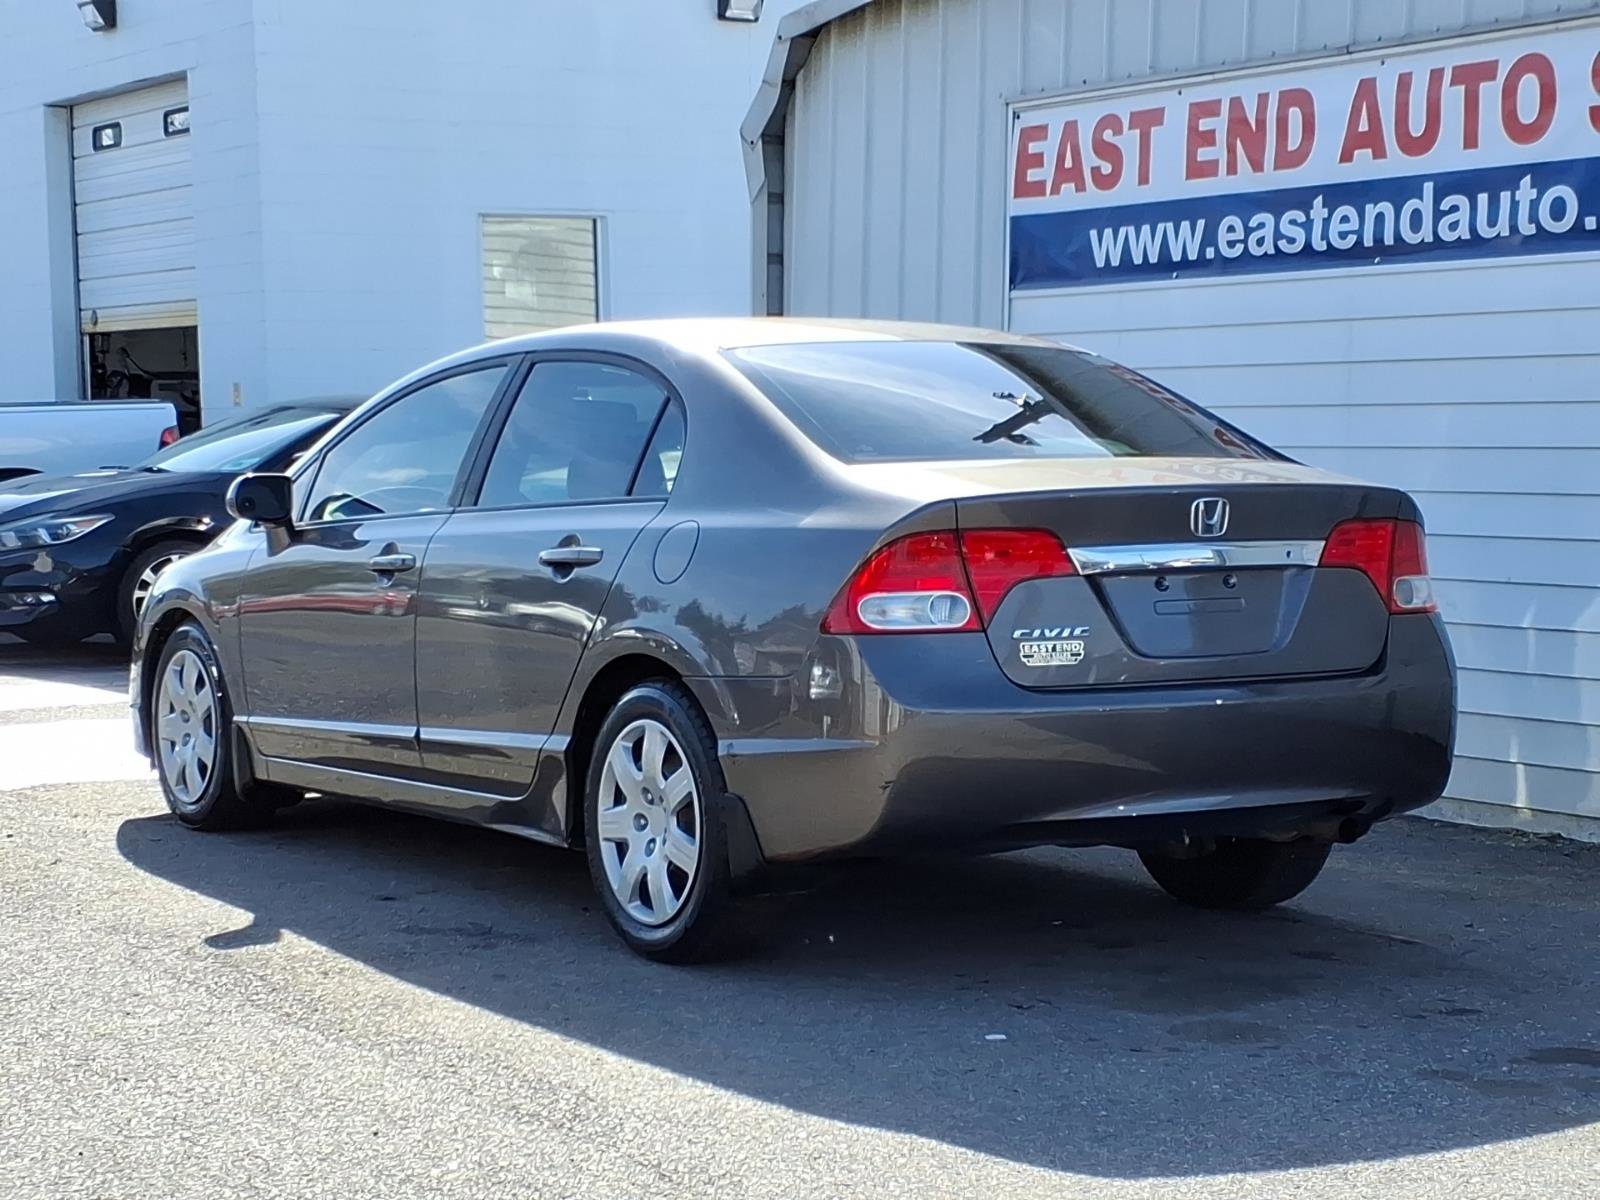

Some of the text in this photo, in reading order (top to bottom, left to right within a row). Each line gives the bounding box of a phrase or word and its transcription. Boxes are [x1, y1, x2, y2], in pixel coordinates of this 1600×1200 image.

[1013, 106, 1166, 199] EAST
[1185, 88, 1317, 180] END
[1338, 52, 1557, 164] AUTO
[1089, 174, 1598, 268] www.eastendauto.
[1012, 626, 1090, 639] CIVIC
[1023, 643, 1080, 653] EAST END
